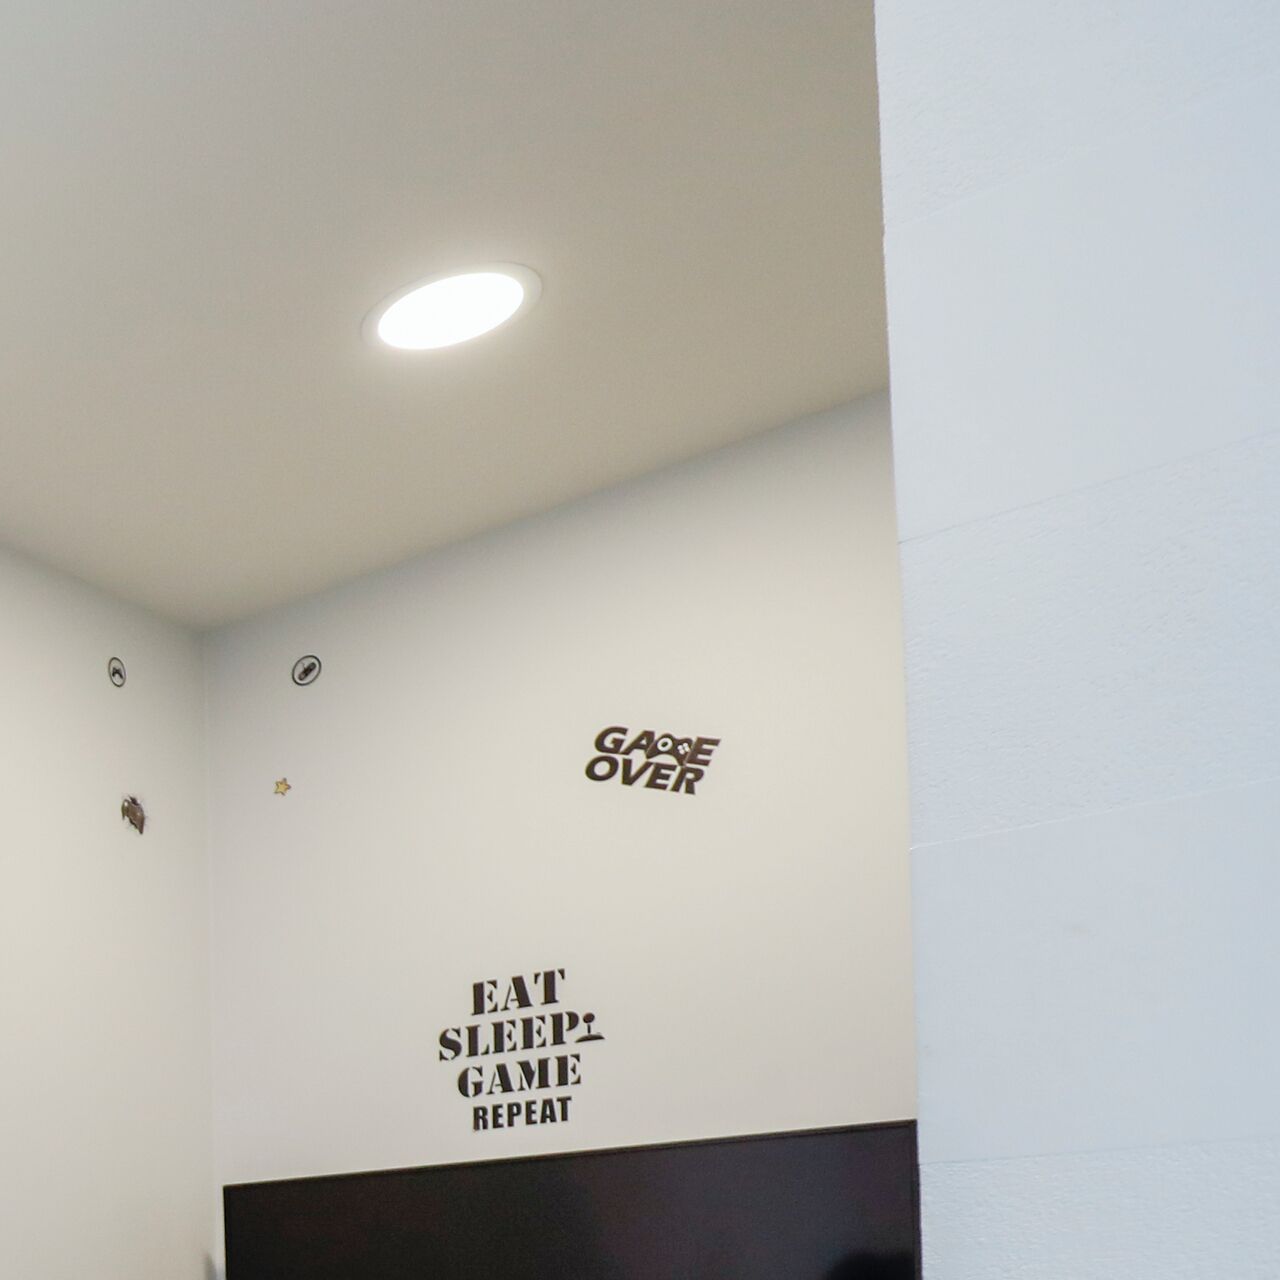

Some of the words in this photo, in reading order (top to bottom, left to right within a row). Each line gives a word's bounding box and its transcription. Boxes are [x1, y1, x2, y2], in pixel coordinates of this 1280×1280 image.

[584, 754, 705, 795] OVER
[471, 968, 566, 1016] EAT
[438, 1010, 580, 1062] SLEEP
[457, 1053, 582, 1098] GAME
[472, 1095, 573, 1131] REPEAT
